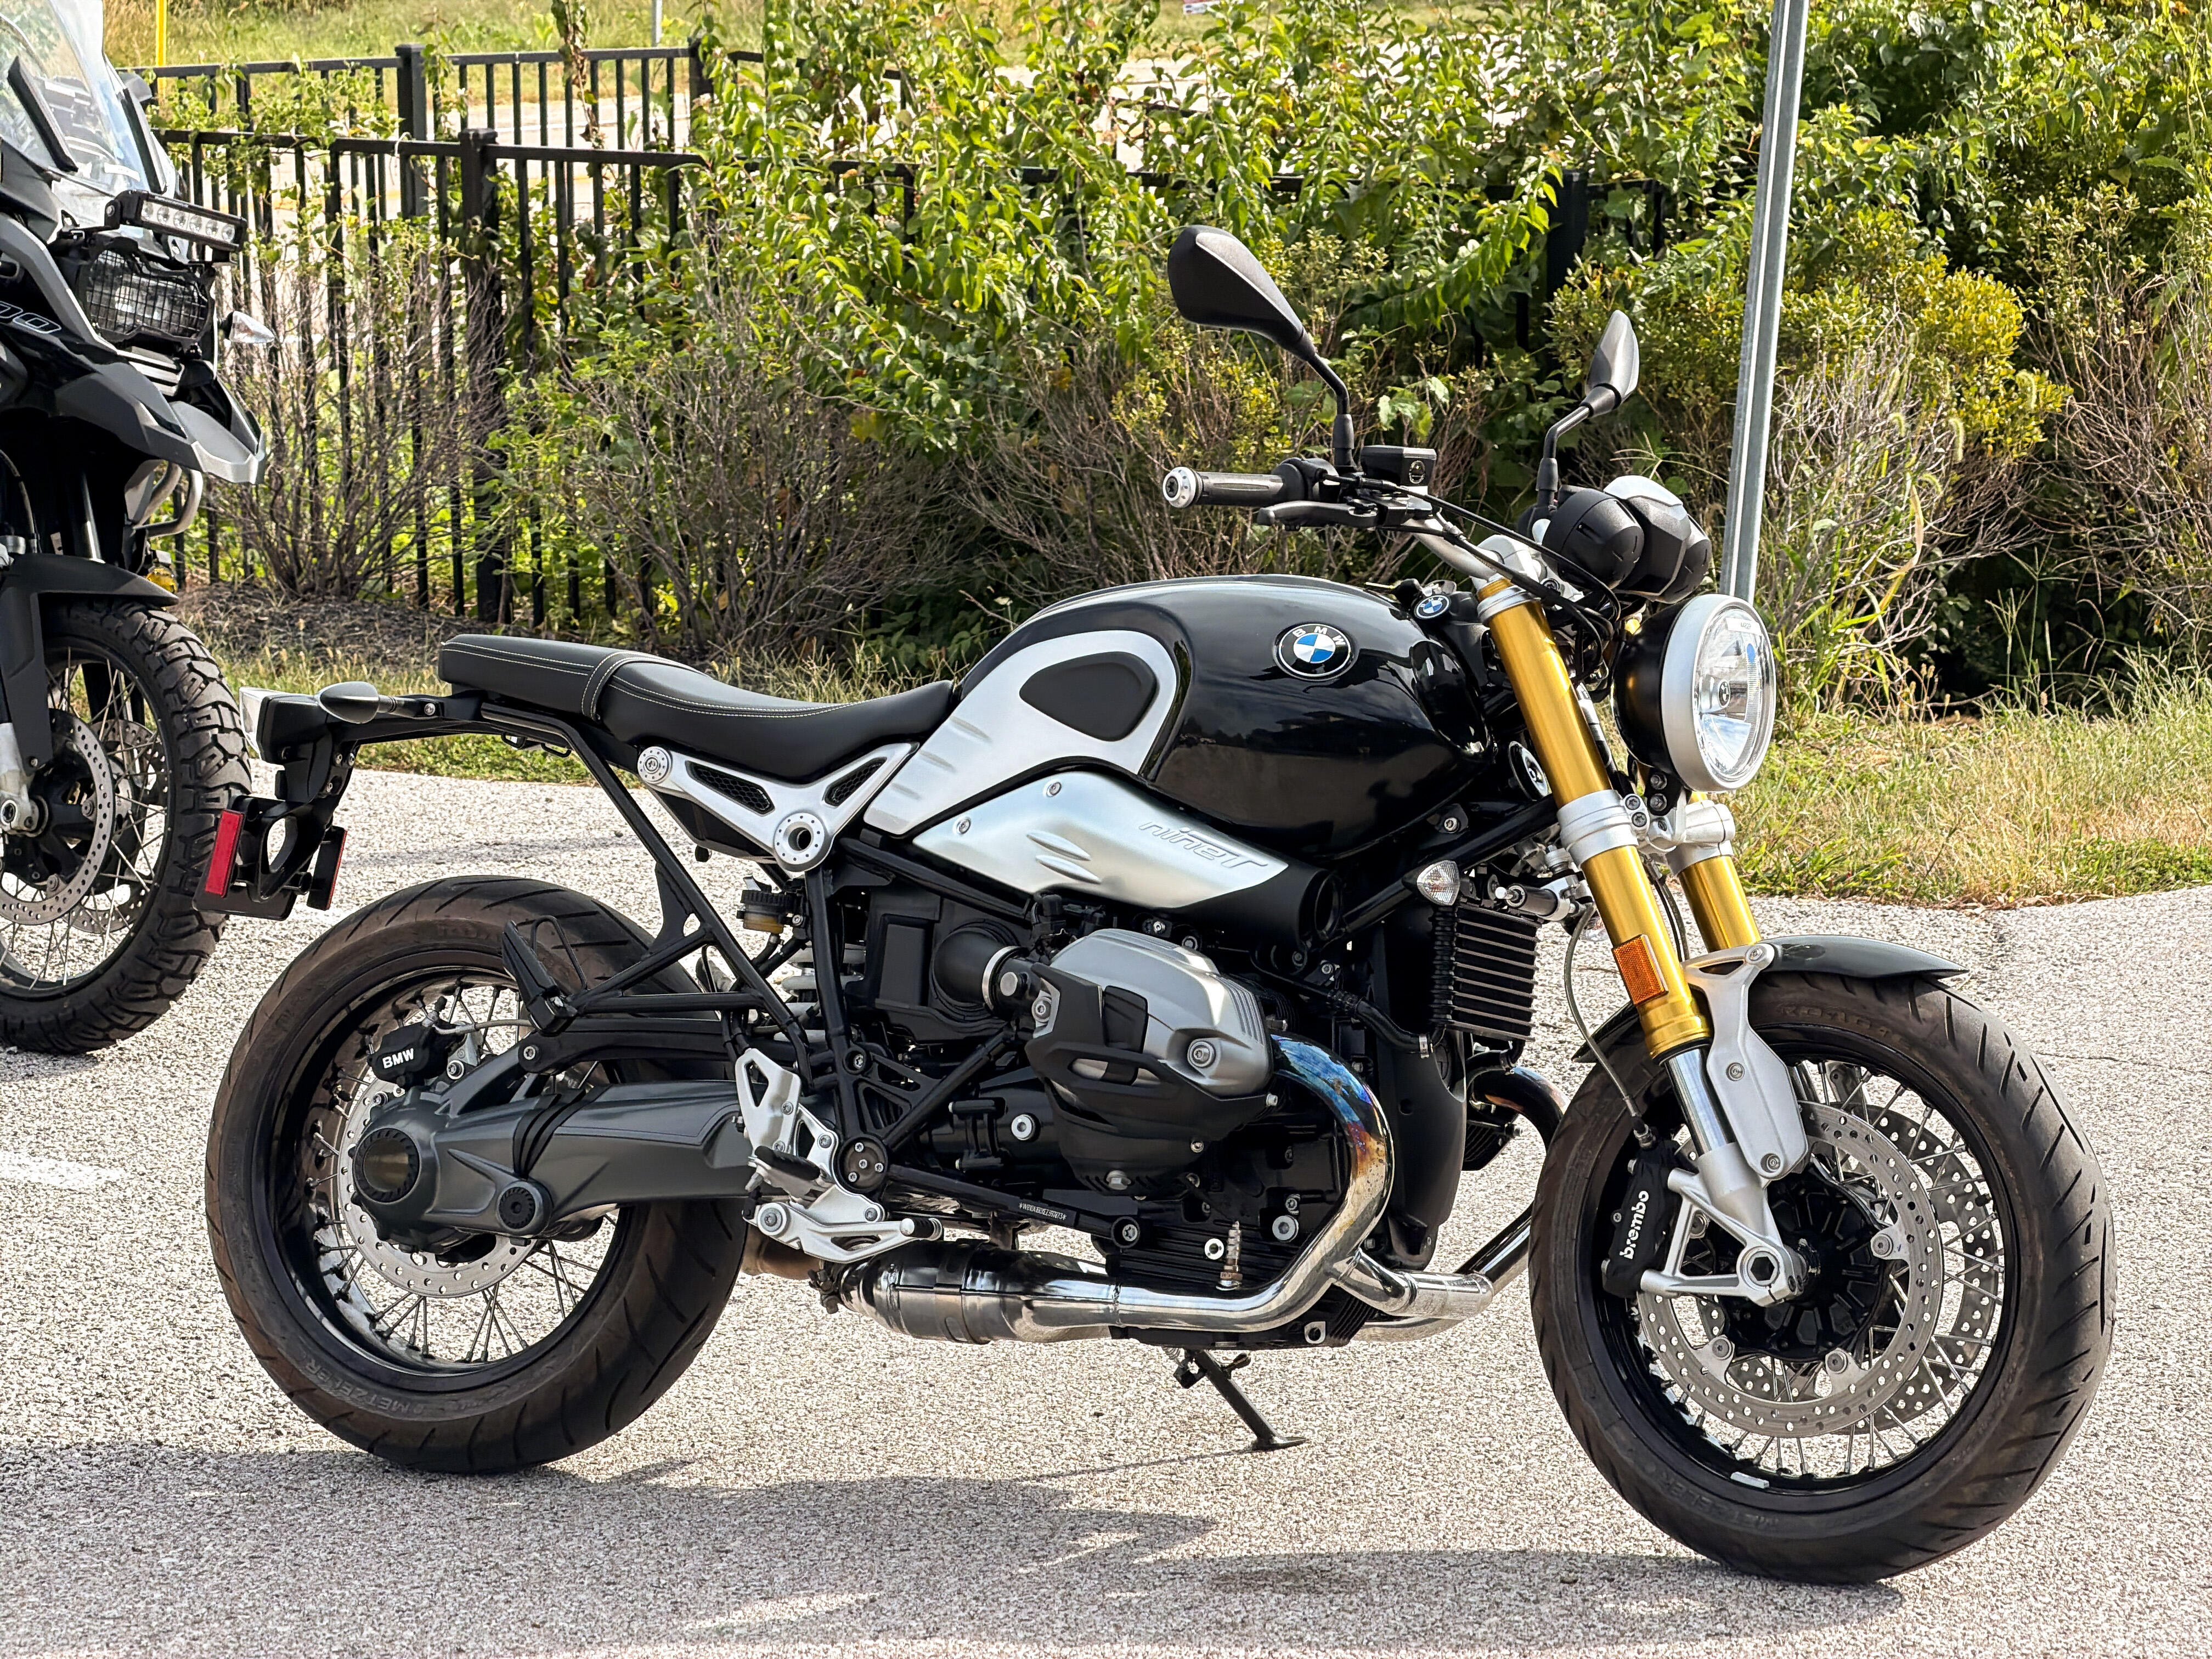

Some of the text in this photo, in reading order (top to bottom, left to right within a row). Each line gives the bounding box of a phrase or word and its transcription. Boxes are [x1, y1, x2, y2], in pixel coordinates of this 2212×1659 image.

[1292, 626, 1346, 646] BMW
[382, 1048, 414, 1069] BMW
[1619, 1190, 1649, 1260] brembo
[305, 1358, 410, 1414] METZELER
